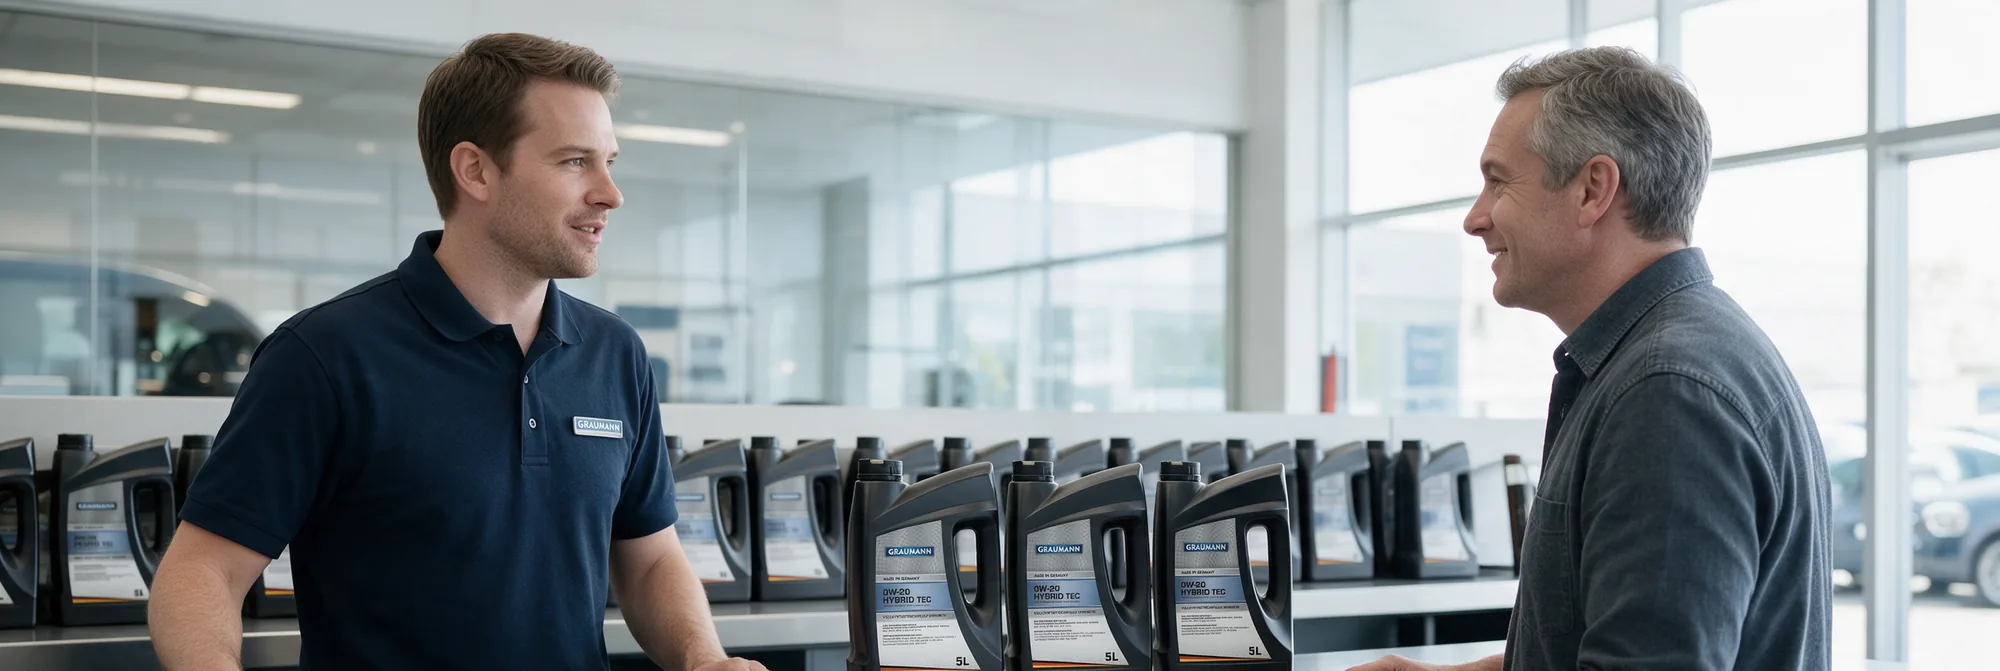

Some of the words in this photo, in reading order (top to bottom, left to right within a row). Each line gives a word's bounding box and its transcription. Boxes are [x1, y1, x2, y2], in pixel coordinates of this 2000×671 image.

[578, 420, 620, 432] GRAUMANN
[883, 596, 915, 604] HYBRID
[1065, 592, 1081, 600] TEC
[1248, 646, 1262, 656] 5L
[955, 656, 970, 666] 5L
[1105, 652, 1119, 662] 5L
